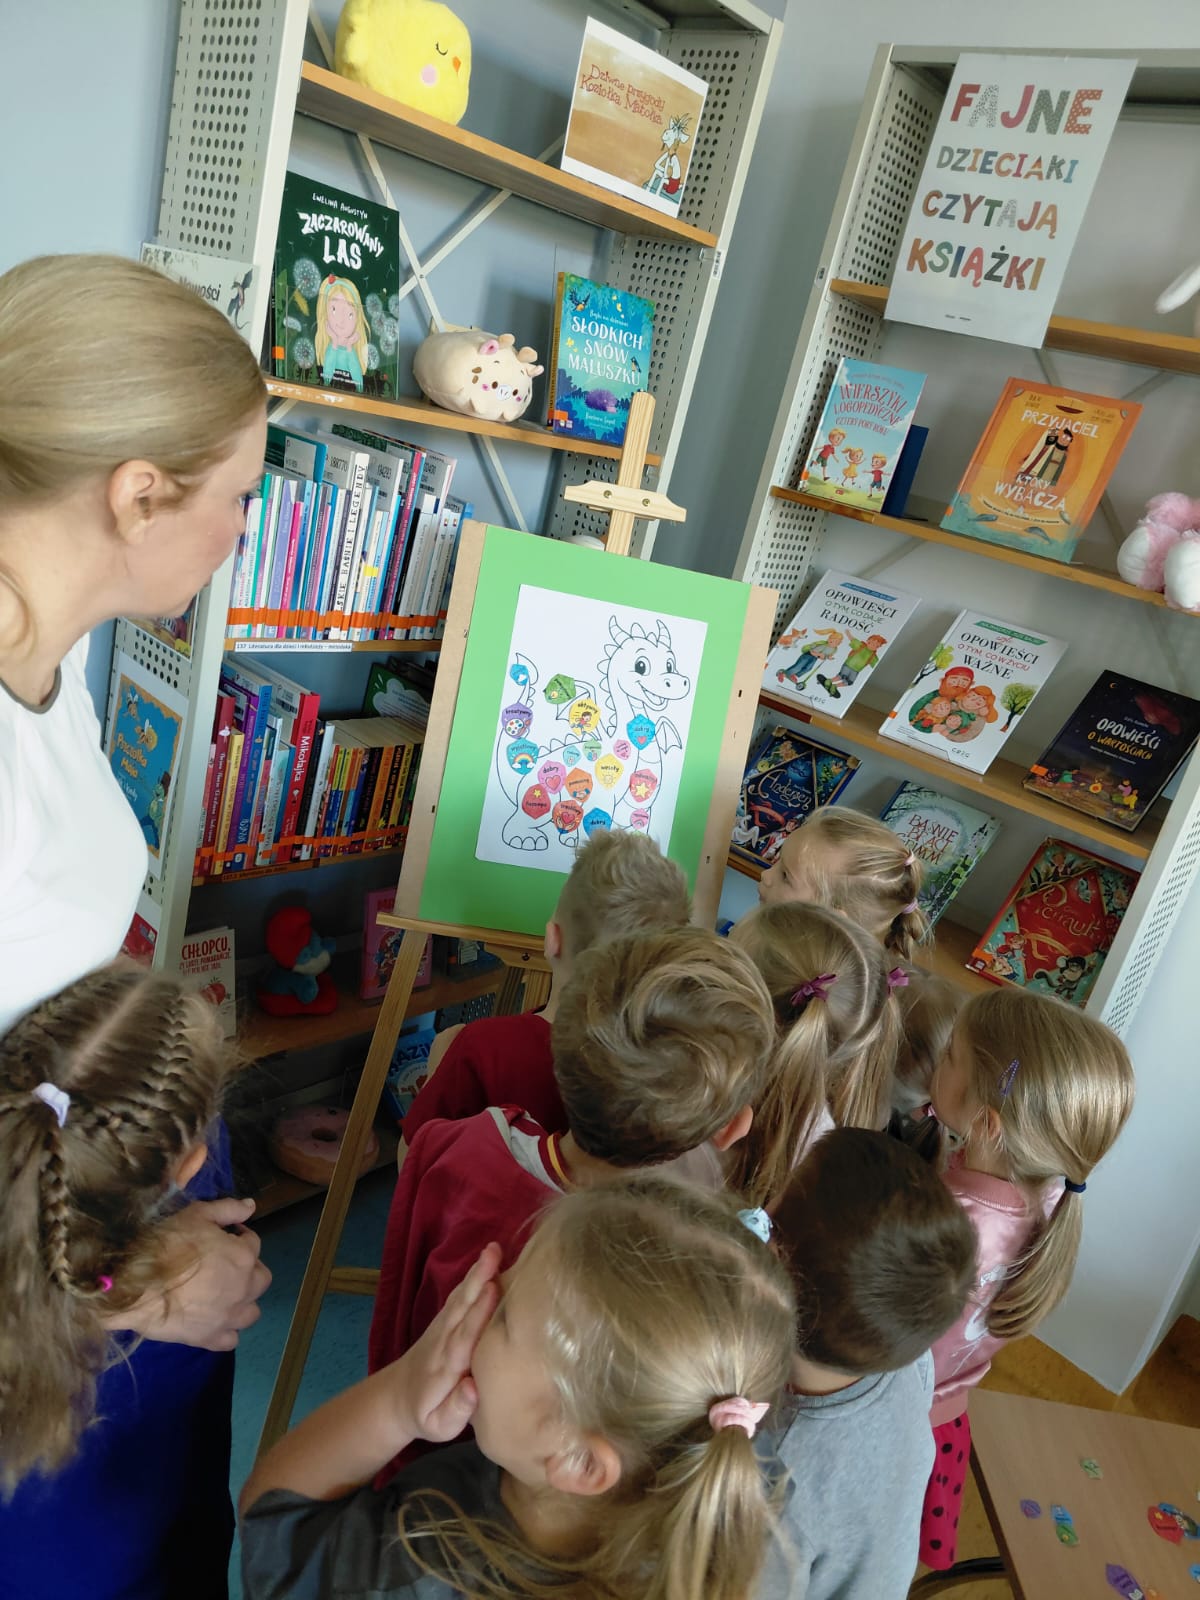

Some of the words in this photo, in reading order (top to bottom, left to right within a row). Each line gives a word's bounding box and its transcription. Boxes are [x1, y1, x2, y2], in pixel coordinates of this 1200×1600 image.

[581, 74, 621, 106] Koziołka
[624, 94, 663, 125] Matołka
[590, 64, 625, 90] Dziwne
[627, 84, 666, 112] przygody
[950, 83, 1103, 135] FAJNE
[936, 146, 1079, 183] DZIECIAKI
[312, 192, 338, 209] EWELINA
[340, 203, 368, 220] AUGUSTYN
[922, 189, 1058, 239] CZYTAJĄ
[297, 211, 384, 258] ZACZAROWANY
[323, 235, 362, 270] LAS
[906, 238, 1046, 291] KSIĄŻKI
[571, 316, 643, 350] SŁODKICH
[584, 339, 630, 365] SNÓW
[568, 353, 641, 385] MALUSZKU
[840, 383, 908, 413] WIERSZYKI
[1021, 410, 1099, 438] PRZYJACIEL
[993, 481, 1067, 511] WYBACZA
[825, 588, 898, 618] OPOWIEŚCI
[820, 609, 874, 634] RADOŚĆ
[961, 632, 1040, 665] OPOWIEŚCI
[963, 654, 1014, 680] WAŻNE
[1087, 731, 1096, 740] O
[1097, 734, 1153, 760] WARTOŚCIACH
[1096, 718, 1161, 750] OPOWIEŚCI
[294, 736, 312, 781] Mikołajka
[543, 766, 559, 774] dobry
[748, 769, 811, 810] Andersen
